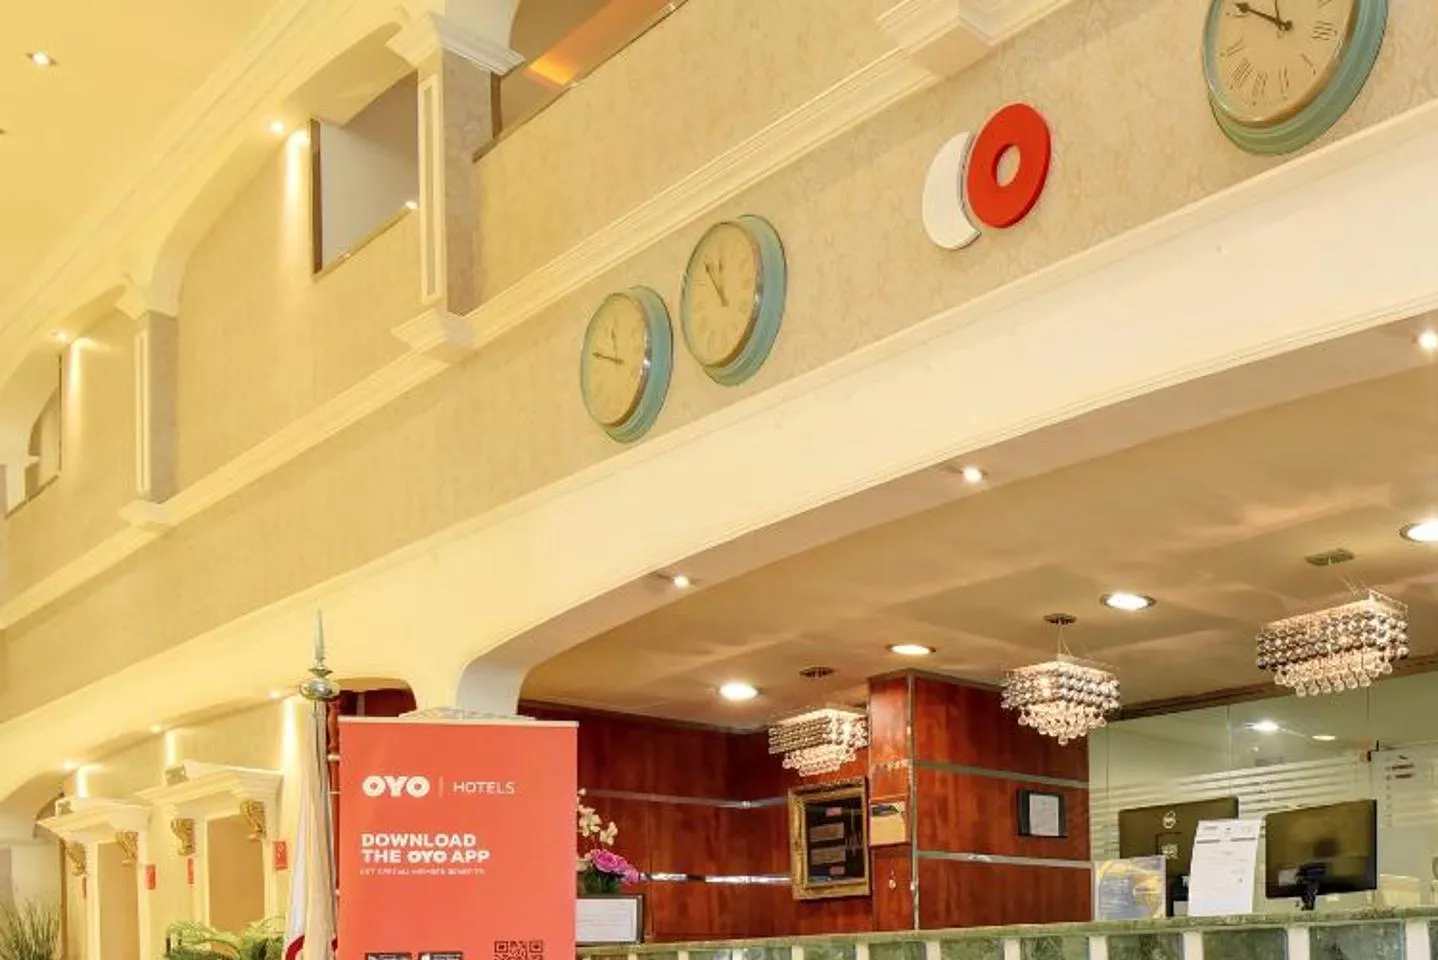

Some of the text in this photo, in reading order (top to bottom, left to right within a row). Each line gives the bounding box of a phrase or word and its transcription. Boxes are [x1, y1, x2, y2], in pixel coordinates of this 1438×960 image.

[361, 775, 516, 798] OYO HOTELS
[360, 833, 477, 848] DOWNLOAD
[361, 849, 490, 864] THE OYO APP
